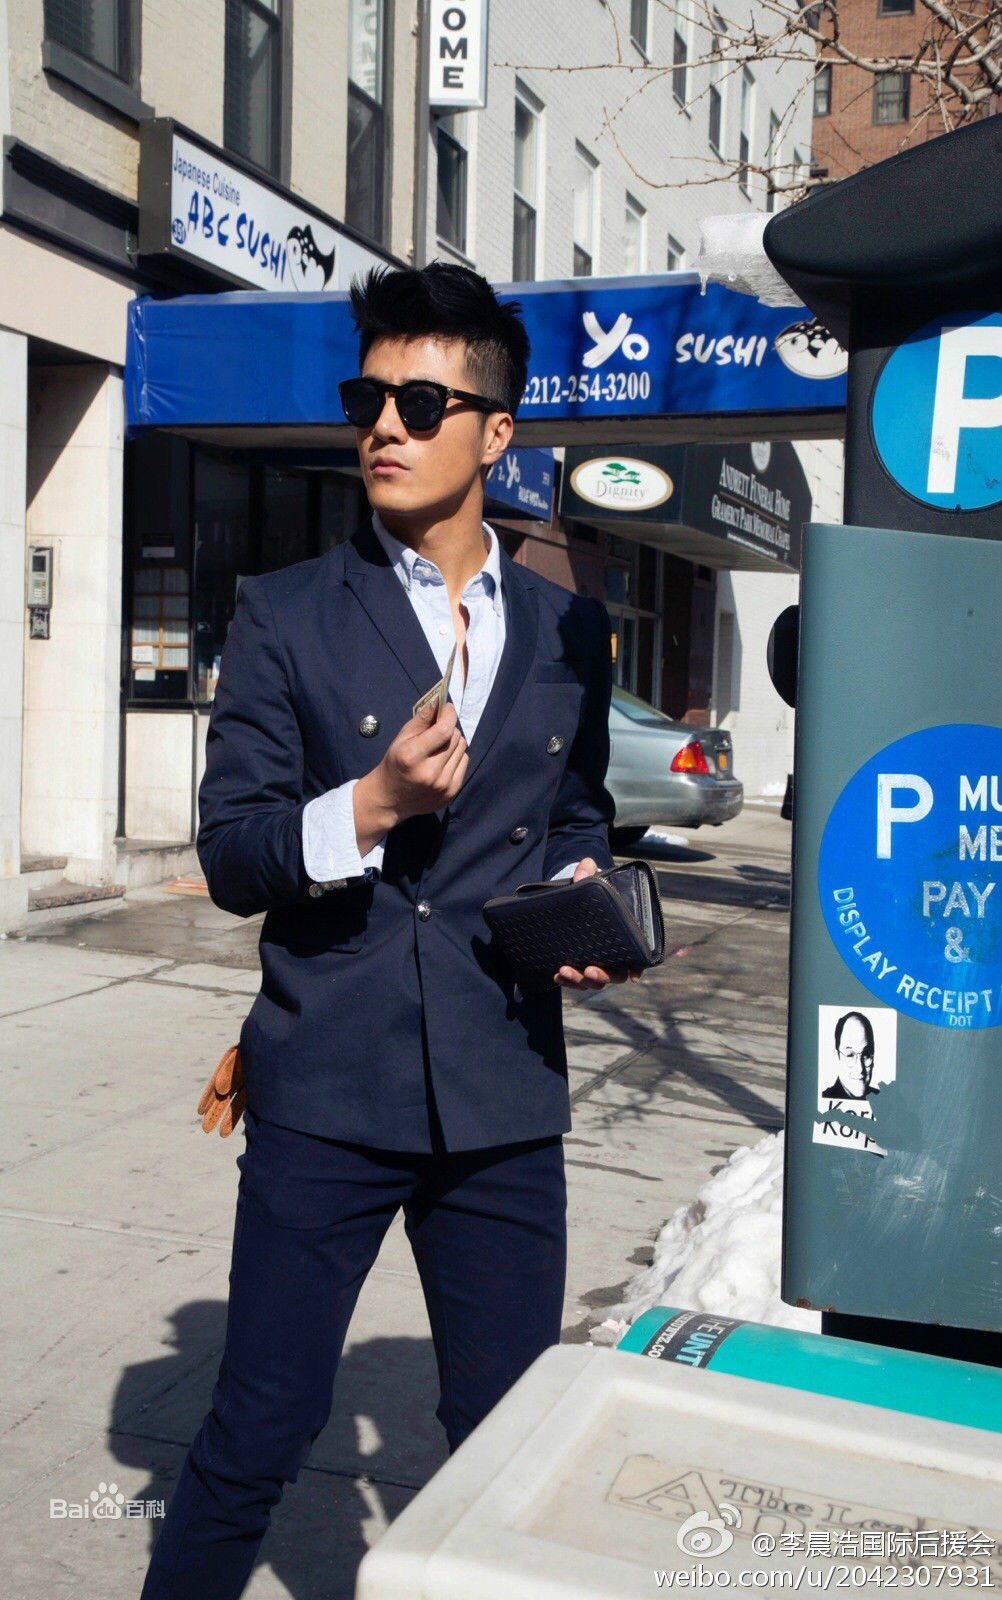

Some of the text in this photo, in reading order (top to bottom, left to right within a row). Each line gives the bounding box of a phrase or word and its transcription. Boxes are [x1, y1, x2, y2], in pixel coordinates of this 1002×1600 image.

[439, 0, 468, 89] OME
[173, 150, 241, 206] Japanese Cuisine
[187, 190, 287, 283] ABC SUSHI
[675, 332, 767, 368] SUSHI
[520, 371, 651, 405] :212-254-3200
[926, 326, 1002, 494] P
[591, 479, 646, 498] Dignity
[876, 773, 935, 860] P
[922, 881, 996, 919] PAY
[832, 886, 993, 1014] DISPLAY RECEIPT
[943, 926, 971, 964] &
[949, 1014, 974, 1028] DOT
